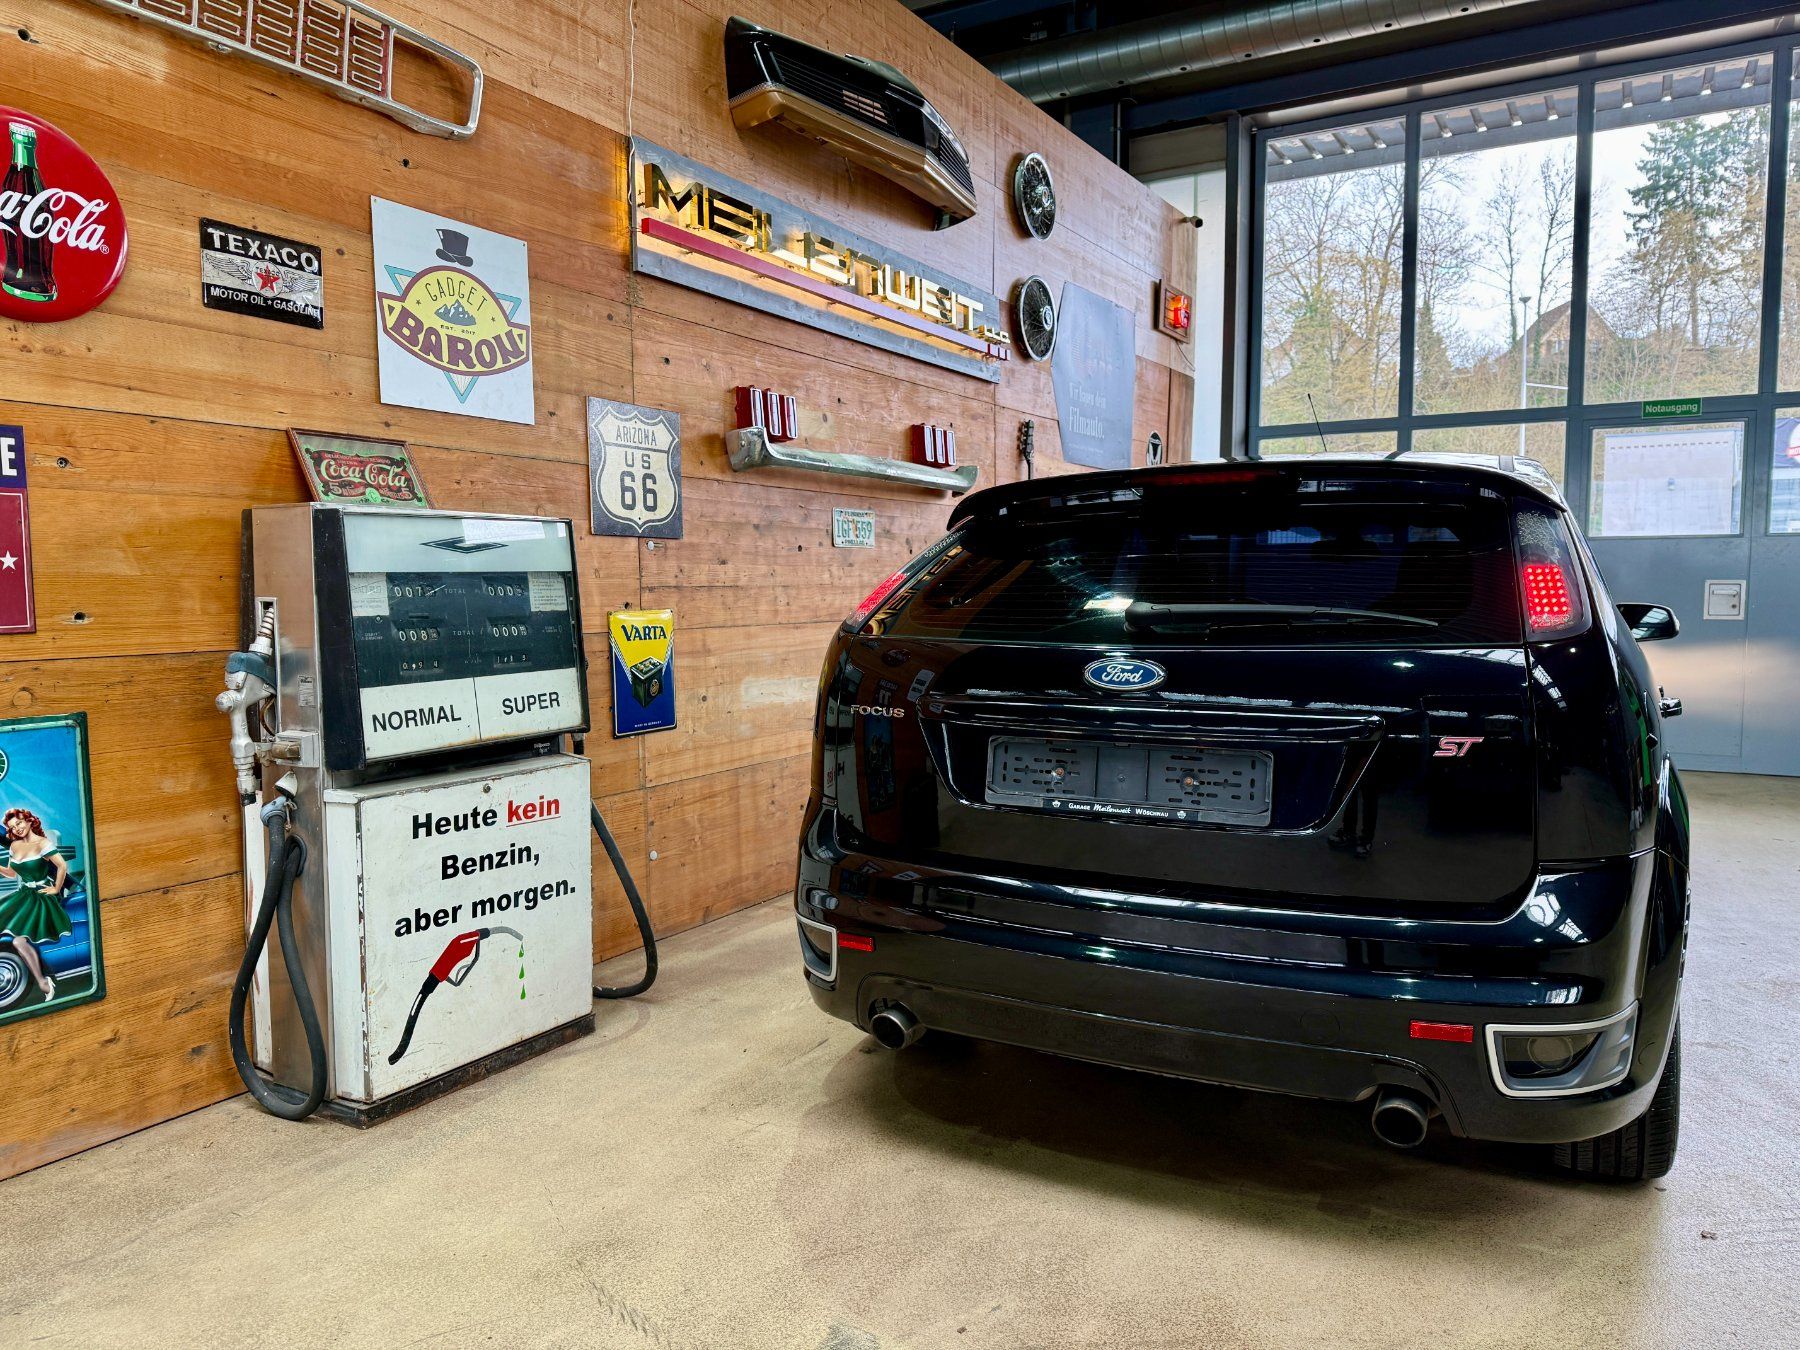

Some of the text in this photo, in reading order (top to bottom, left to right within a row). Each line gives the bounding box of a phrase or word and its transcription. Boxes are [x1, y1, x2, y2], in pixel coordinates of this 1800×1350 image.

[207, 227, 319, 274] TEXACO
[210, 285, 321, 319] MOTOR OIL GASOLINE
[425, 277, 488, 312] GADGET
[389, 304, 526, 370] BARON
[1645, 403, 1698, 413] Notausgang
[616, 425, 658, 446] ARIZONA
[620, 470, 658, 512] 66
[621, 624, 668, 642] VARTA
[1101, 664, 1144, 683] Ford
[372, 691, 561, 733] NORMAL SUPER
[850, 704, 905, 718] FOCUS
[1432, 736, 1485, 757] ST
[412, 795, 561, 840] Heute kein
[1093, 803, 1132, 814] Meilenweit
[441, 842, 540, 881] Benzin,
[394, 879, 576, 938] aber morgen.
